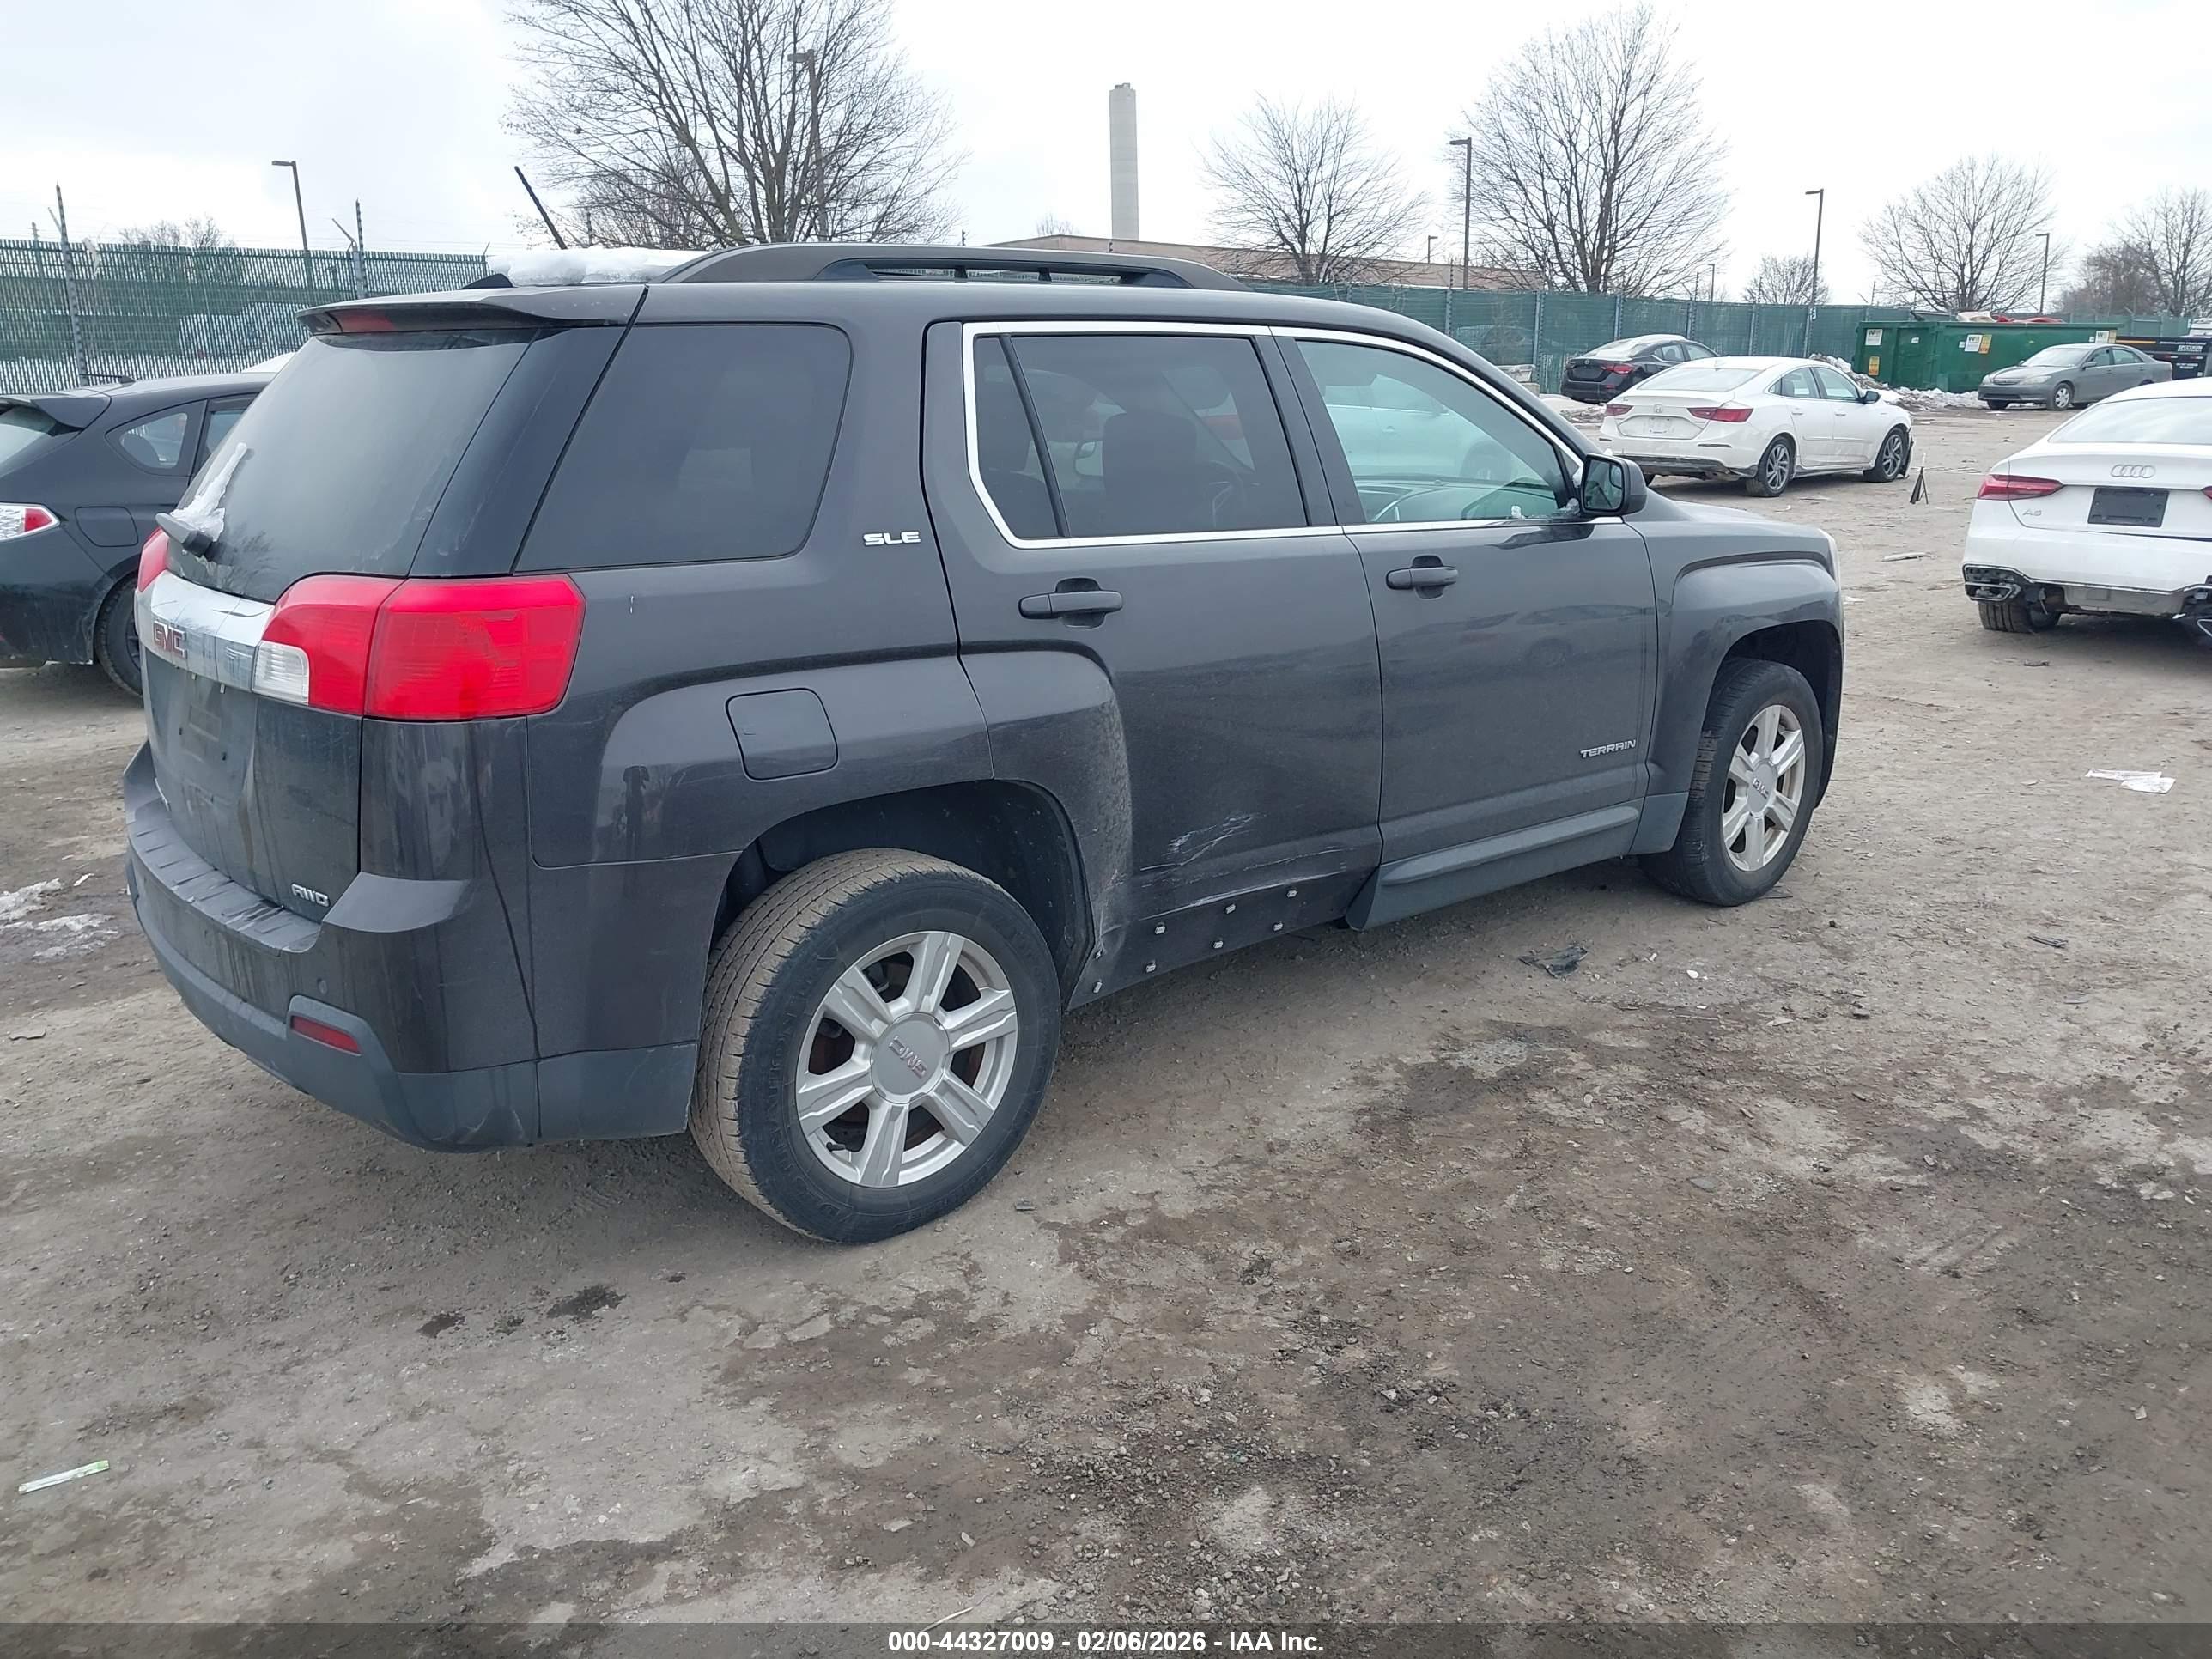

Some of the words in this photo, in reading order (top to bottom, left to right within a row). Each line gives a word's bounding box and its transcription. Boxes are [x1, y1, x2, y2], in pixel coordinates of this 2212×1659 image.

[863, 531, 921, 546] SLE
[153, 619, 188, 659] GMC
[1580, 739, 1636, 758] TERRAIN
[291, 883, 329, 907] AWD
[888, 1035, 927, 1079] GMC
